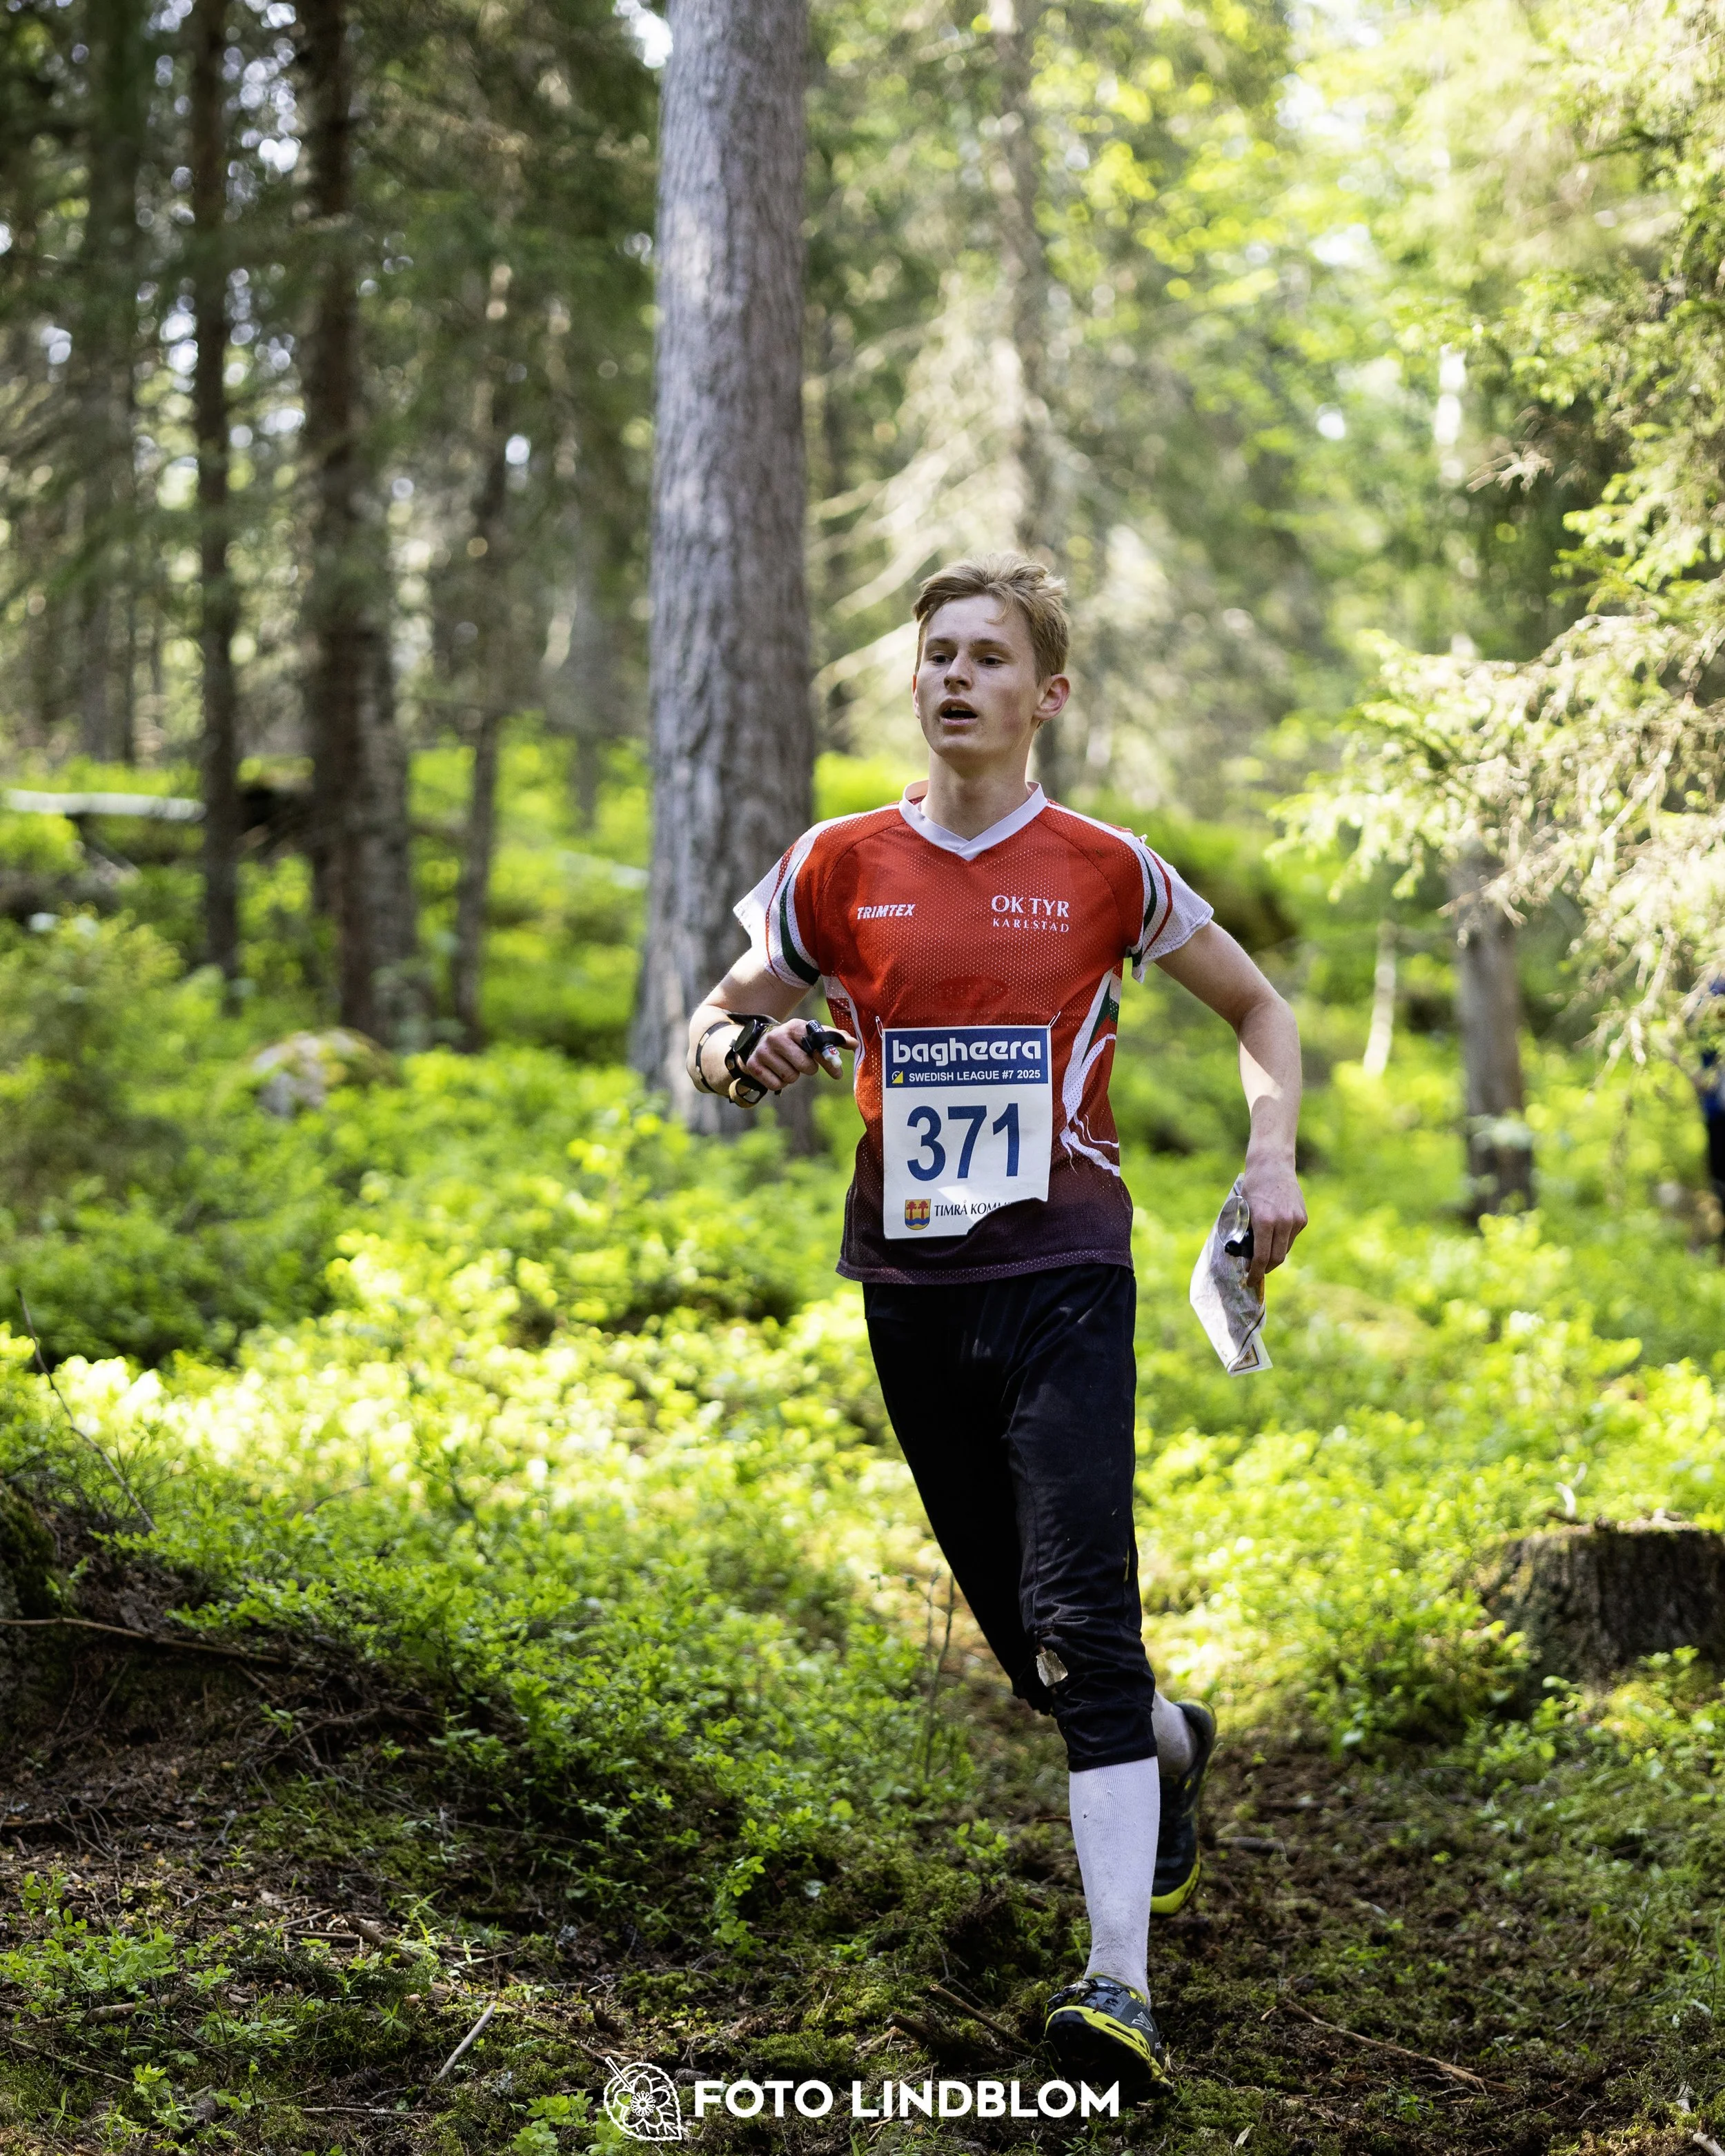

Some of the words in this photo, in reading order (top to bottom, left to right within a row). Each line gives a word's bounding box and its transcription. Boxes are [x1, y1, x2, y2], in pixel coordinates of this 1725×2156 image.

[857, 904, 916, 920] TRIMTEX
[991, 895, 1024, 913] OK
[1029, 898, 1070, 918] TYR
[993, 918, 1070, 933] KARLSTAD
[893, 1038, 1041, 1067] bagheera
[909, 1072, 954, 1082] SWEDISH
[957, 1070, 999, 1081] LEAGUE
[1002, 1070, 1014, 1079] #7
[1017, 1069, 1041, 1078] 2025
[907, 1102, 1020, 1181] 371
[934, 1200, 967, 1216] TIMRÅ
